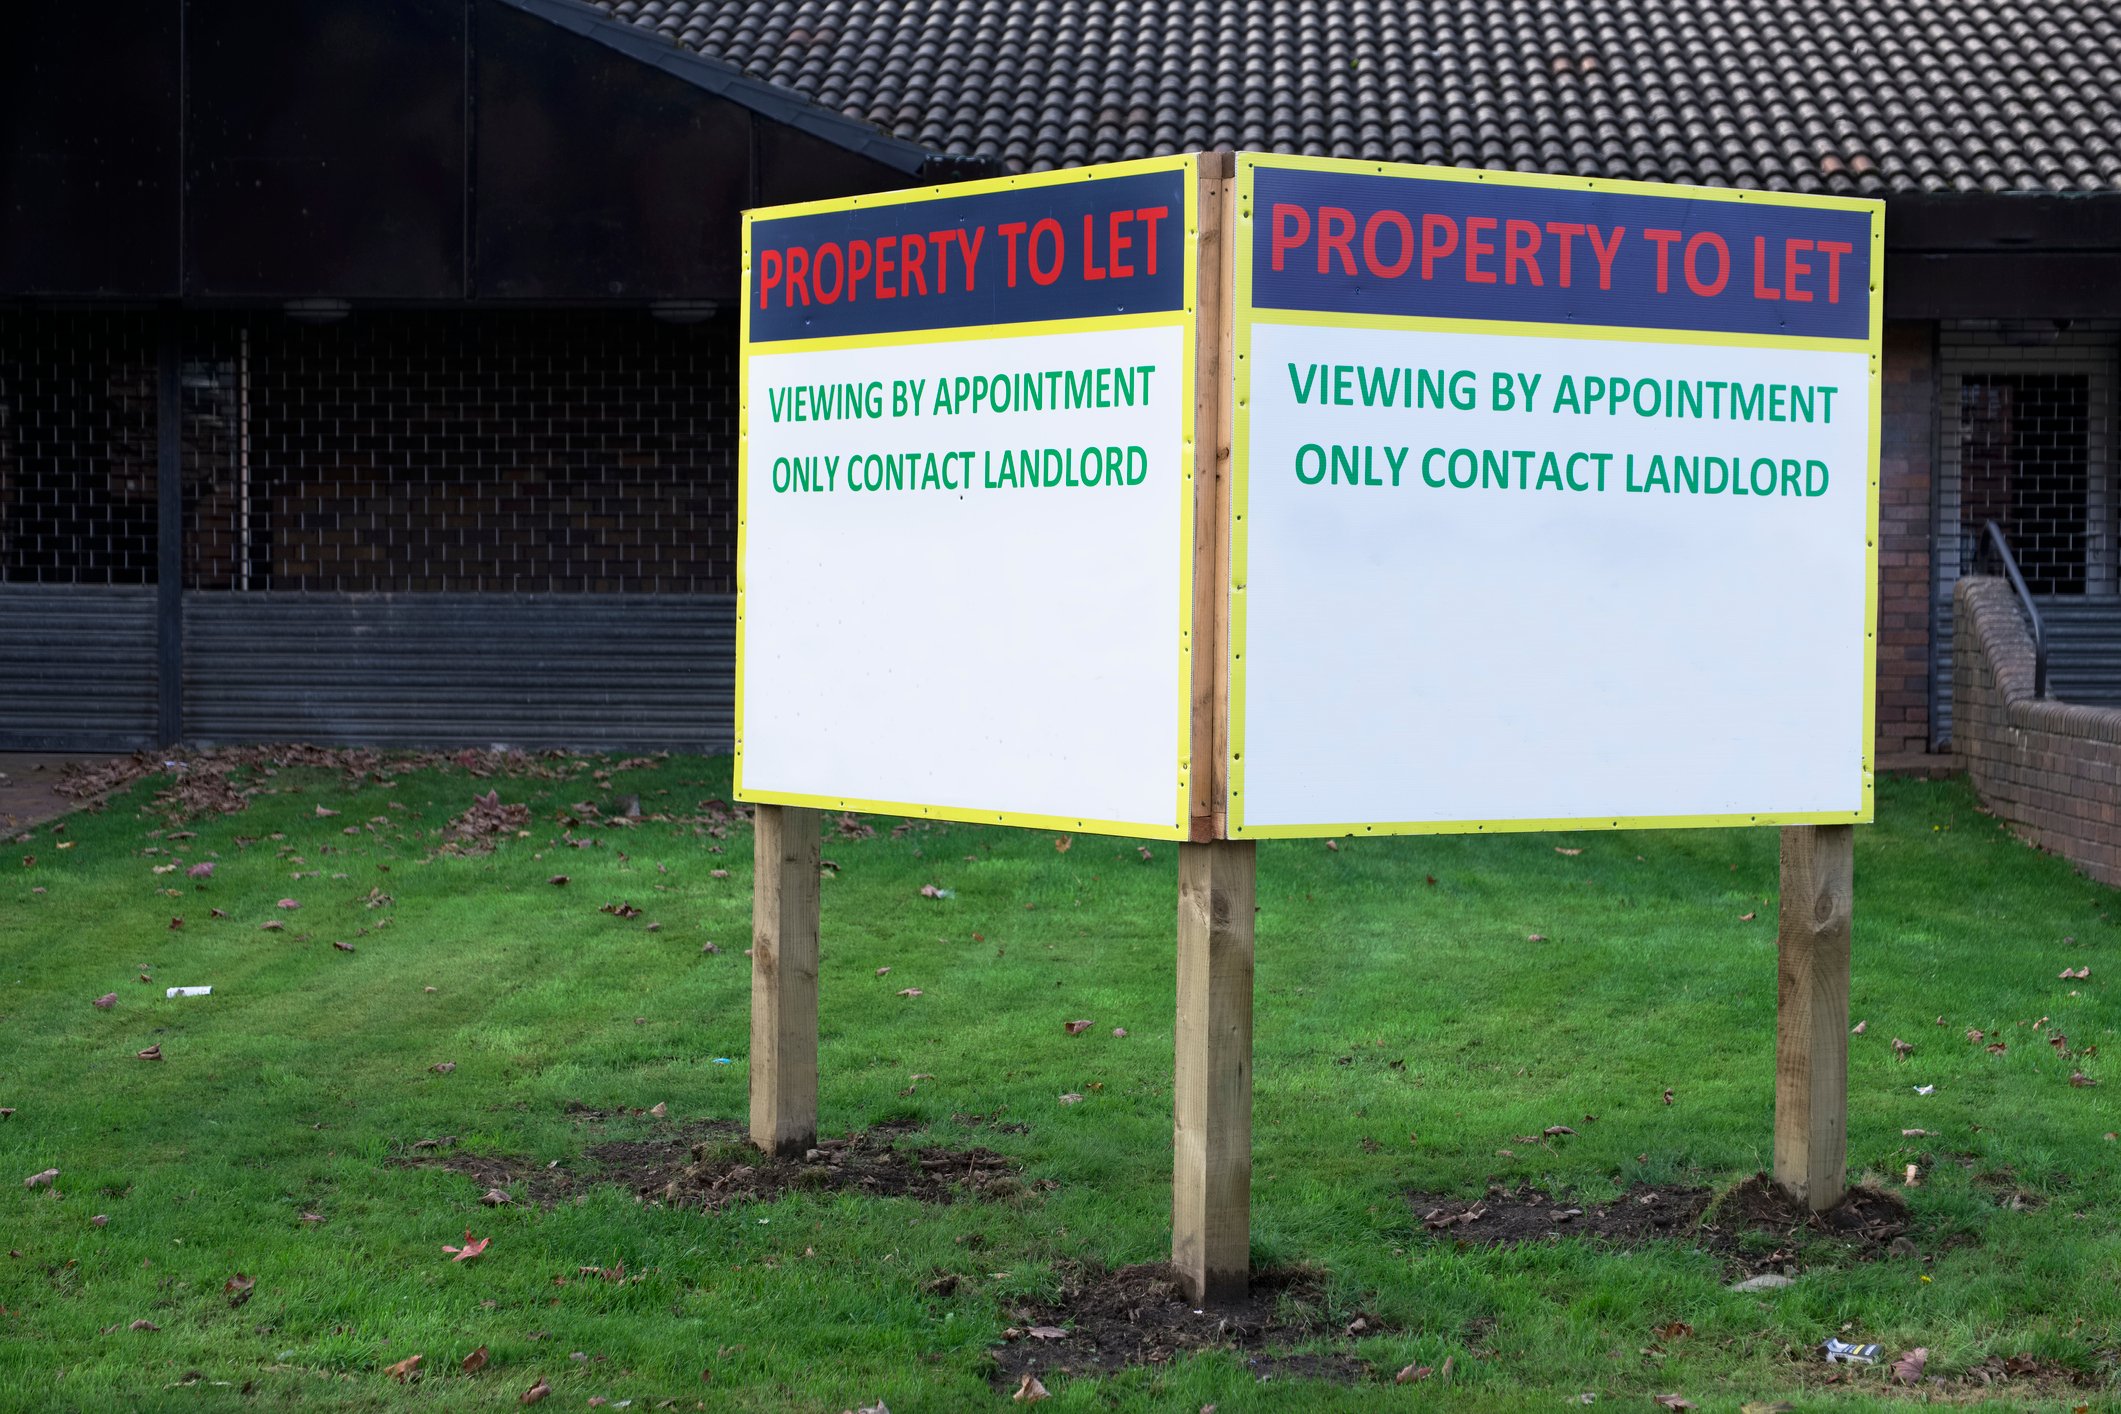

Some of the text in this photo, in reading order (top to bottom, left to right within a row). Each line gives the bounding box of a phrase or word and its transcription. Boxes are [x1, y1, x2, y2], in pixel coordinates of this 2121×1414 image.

[759, 206, 1169, 310] PROPERTY TO LET
[1271, 203, 1853, 304] PROPERTY TO LET
[768, 364, 1157, 424] VIEWING BY APPOINTMENT
[1286, 361, 1840, 426] VIEWING BY APPOINTMENT
[771, 444, 1149, 494] ONLY CONTACT LANDLORD
[1294, 442, 1830, 498] ONLY CONTACT LANDLORD
